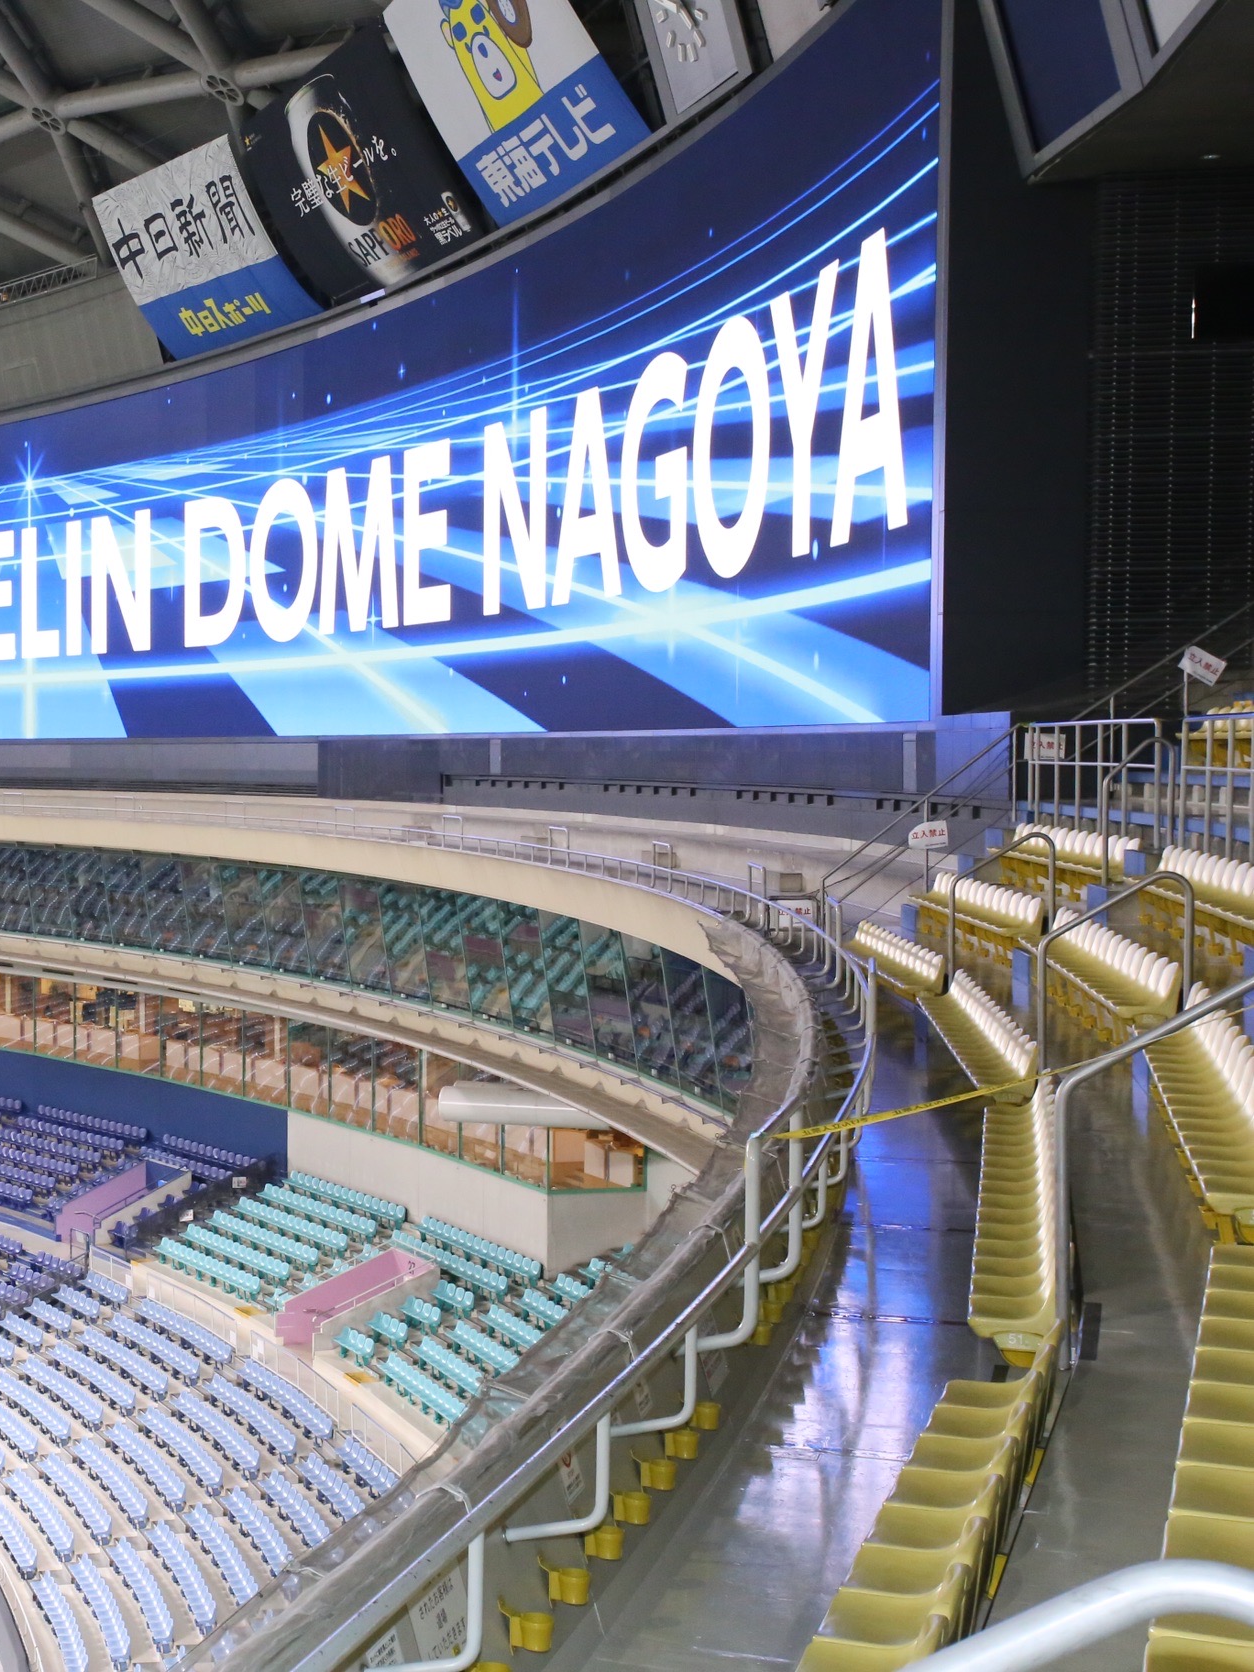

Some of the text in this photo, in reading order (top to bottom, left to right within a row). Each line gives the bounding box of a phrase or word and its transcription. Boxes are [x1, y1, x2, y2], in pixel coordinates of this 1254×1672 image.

[476, 84, 616, 207] 東海テレビ
[112, 174, 256, 280] 中日新聞
[178, 292, 272, 337] 中日スポーツ
[183, 437, 451, 648] DOME
[483, 226, 909, 617] NAGOYA
[1188, 651, 1220, 677] 立入禁止
[911, 828, 946, 840] 立入禁止
[1008, 1333, 1023, 1345] 51
